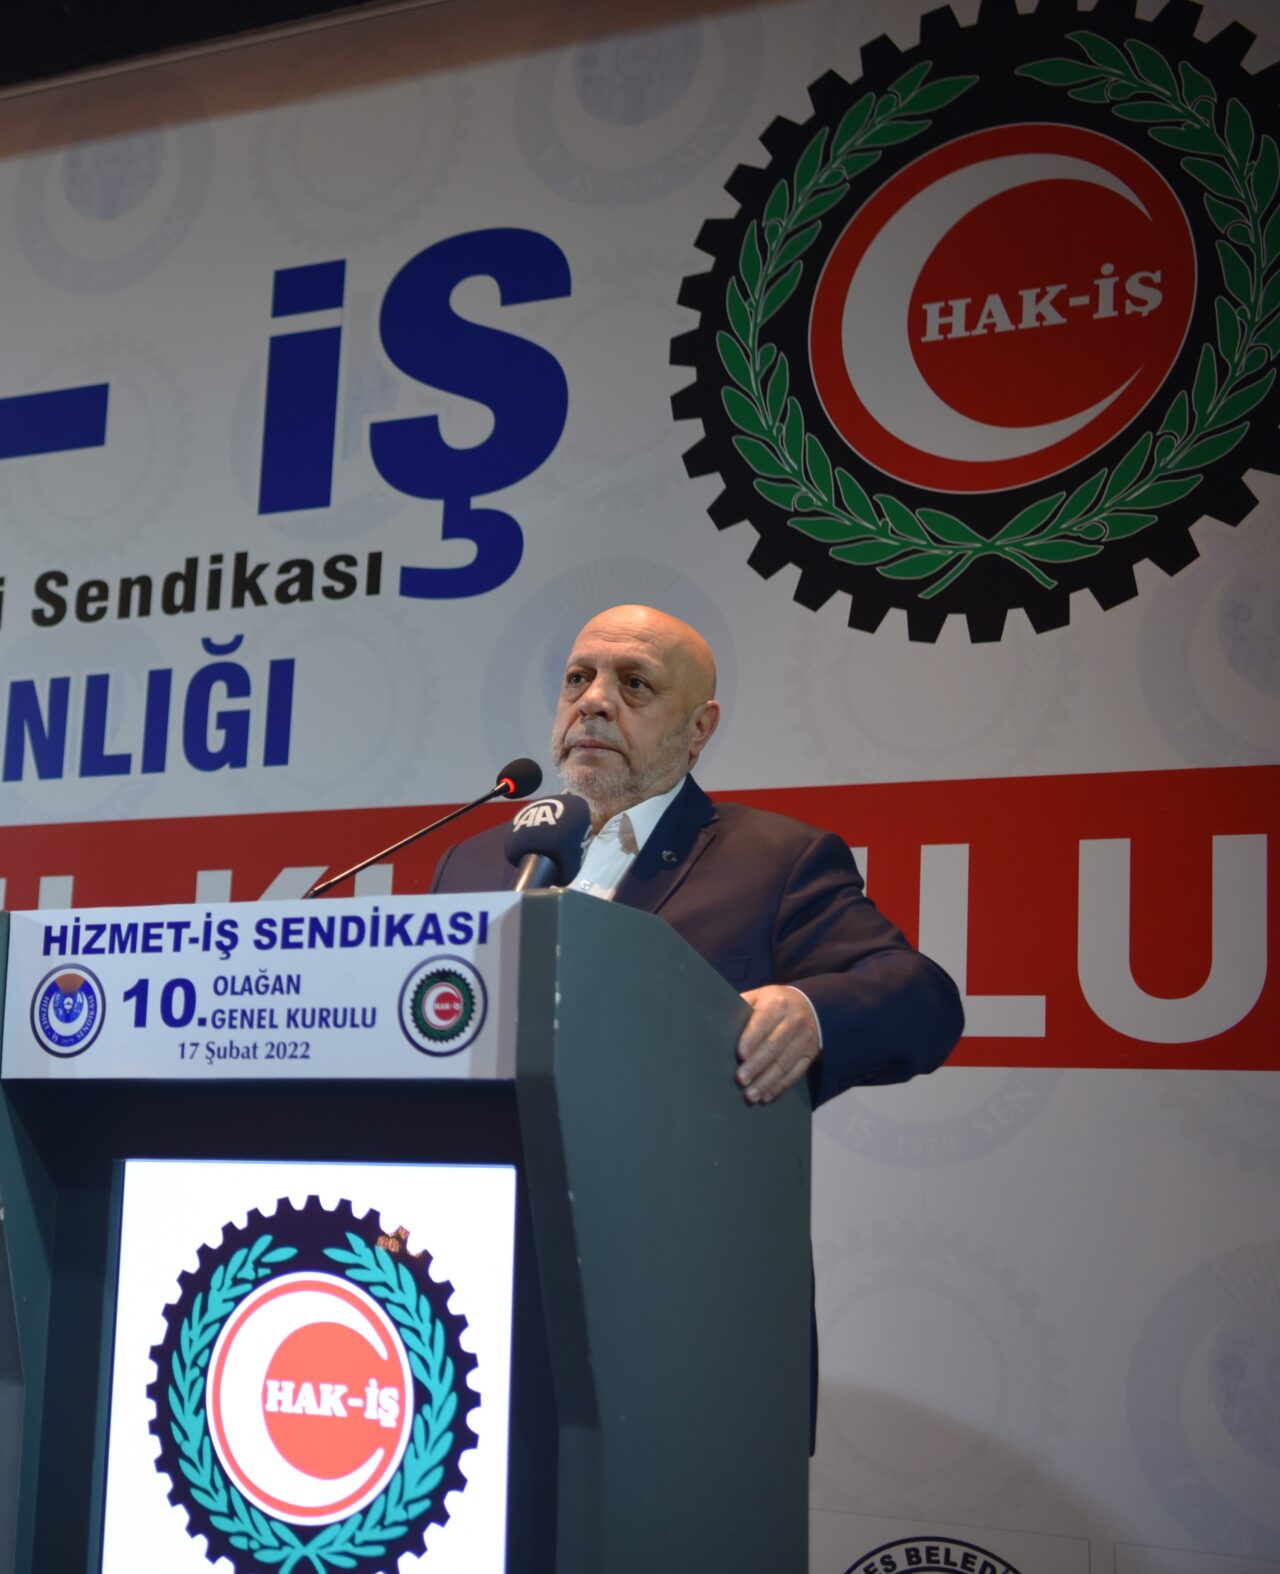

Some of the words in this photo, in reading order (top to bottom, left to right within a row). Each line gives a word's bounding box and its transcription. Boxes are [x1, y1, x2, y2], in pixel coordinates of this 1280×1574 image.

[920, 262, 1163, 342] HAK-İŞ
[30, 551, 383, 628] Sendikası
[42, 911, 239, 960] HİZMET-İŞ
[253, 906, 489, 951] SENDİKASI
[122, 977, 207, 1029] 10.
[213, 968, 301, 997] OLAĞAN
[211, 1008, 279, 1030] GENEL
[286, 1007, 377, 1030] KURULU
[177, 1042, 200, 1060] 17
[205, 1041, 258, 1064] Şubat
[264, 1041, 311, 1060] 2022
[265, 1378, 400, 1428] HAK-İŞ
[904, 1546, 1010, 1574] BELED
